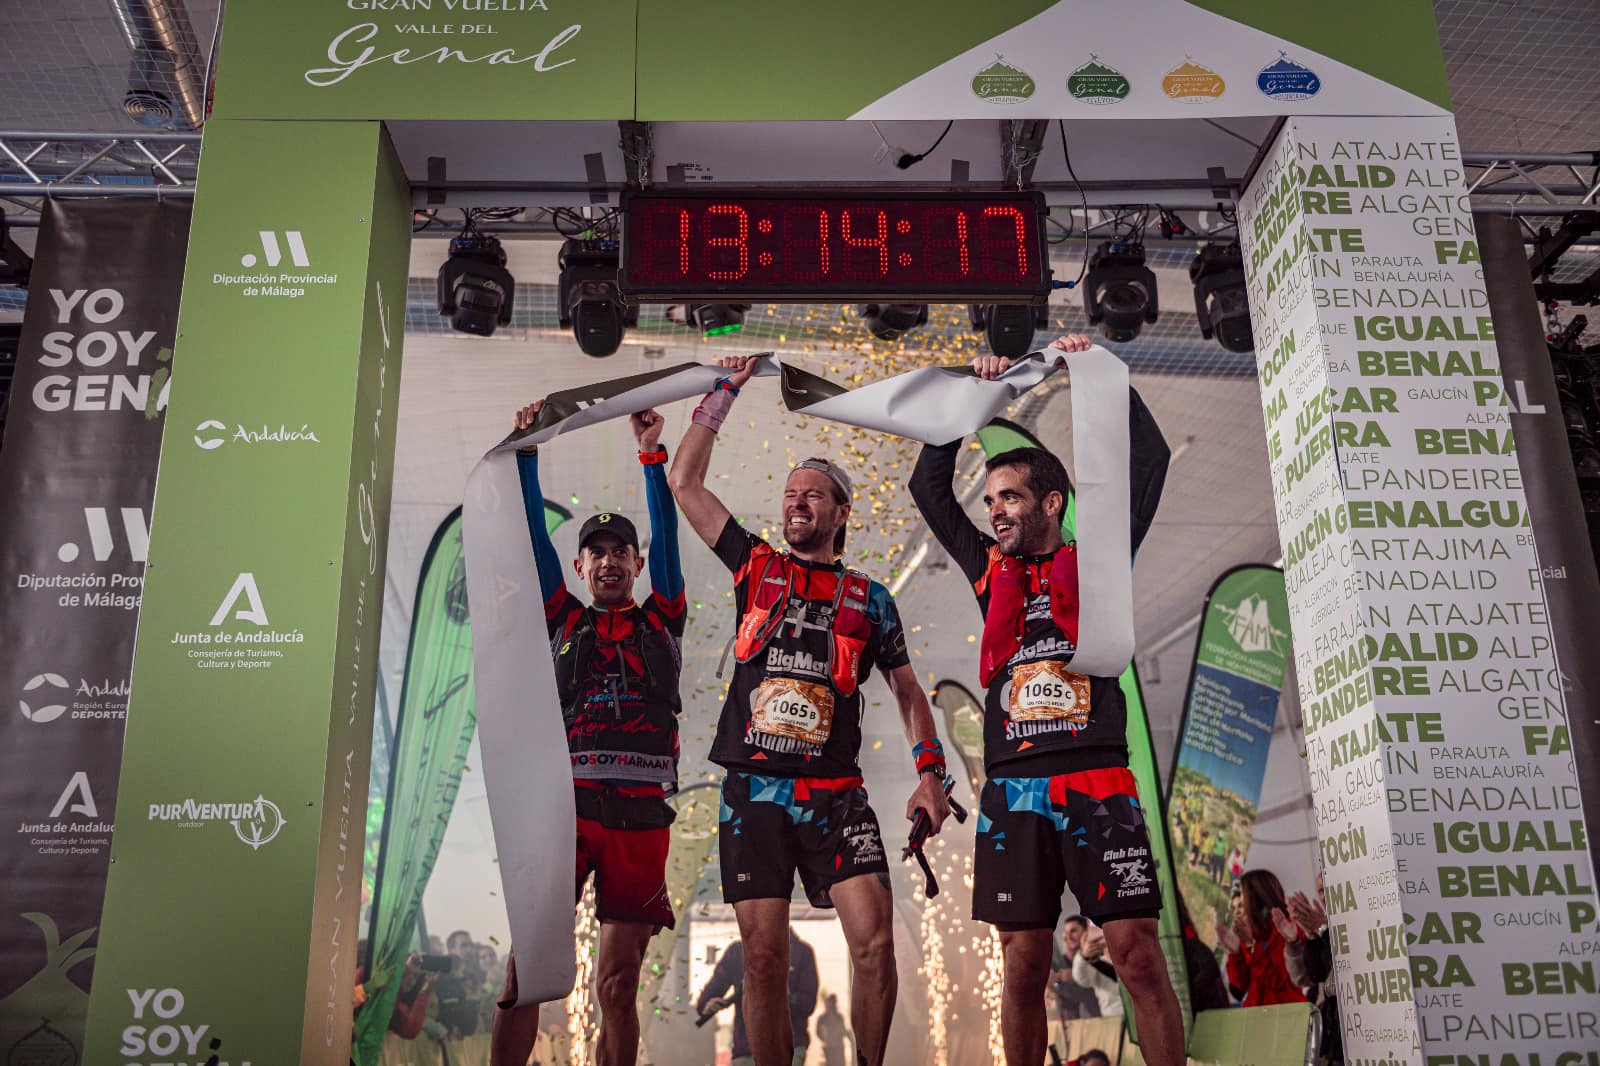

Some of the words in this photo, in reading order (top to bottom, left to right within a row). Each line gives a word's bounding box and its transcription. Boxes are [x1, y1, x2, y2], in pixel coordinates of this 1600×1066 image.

[394, 24, 454, 34] VALLE
[460, 24, 498, 34] DEL
[304, 22, 582, 87] Genal
[1331, 141, 1459, 161] ATAJATE
[1405, 168, 1466, 188] ALP
[1412, 217, 1474, 236] GEN
[679, 204, 1028, 280] 13:14:17
[1351, 257, 1424, 268] PARAUTA
[213, 273, 277, 287] Diputación
[280, 273, 337, 284] Provincial
[1354, 269, 1454, 282] BENALAURÍA
[243, 286, 258, 296] de
[261, 286, 305, 298] Málaga
[1313, 288, 1489, 309] BENADALID
[49, 288, 124, 324] YO
[38, 331, 158, 368] SOY
[1357, 351, 1502, 377] BENAL
[1408, 387, 1468, 400] GAUCÍN
[1466, 413, 1511, 424] ALPA
[233, 423, 320, 443] Andalucía
[18, 573, 107, 591] Diputación
[59, 593, 80, 608] de
[84, 593, 142, 610] Málaga
[1406, 602, 1548, 626] ATAJATE
[171, 632, 211, 644] Junta
[215, 631, 232, 643] de
[235, 629, 304, 643] Andalucía
[188, 649, 232, 659] Consejería
[234, 649, 245, 657] de
[197, 660, 229, 669] Cultura
[230, 662, 236, 670] y
[237, 660, 271, 669] Deporte
[1497, 697, 1565, 721] GEN
[1430, 746, 1511, 761] PARAUTA
[1433, 762, 1545, 781] BENALAURÍA
[1386, 786, 1581, 814] BENADALID
[18, 822, 50, 834] Junta
[53, 822, 67, 833] de
[335, 748, 354, 902] VUELTA
[1103, 848, 1126, 861] Club
[1437, 864, 1594, 899] BENAL
[1493, 909, 1562, 927] GAUCÍN
[1566, 901, 1600, 934] P
[1501, 961, 1600, 997] BEN
[127, 988, 185, 1019] YO
[120, 1025, 209, 1057] SOY
